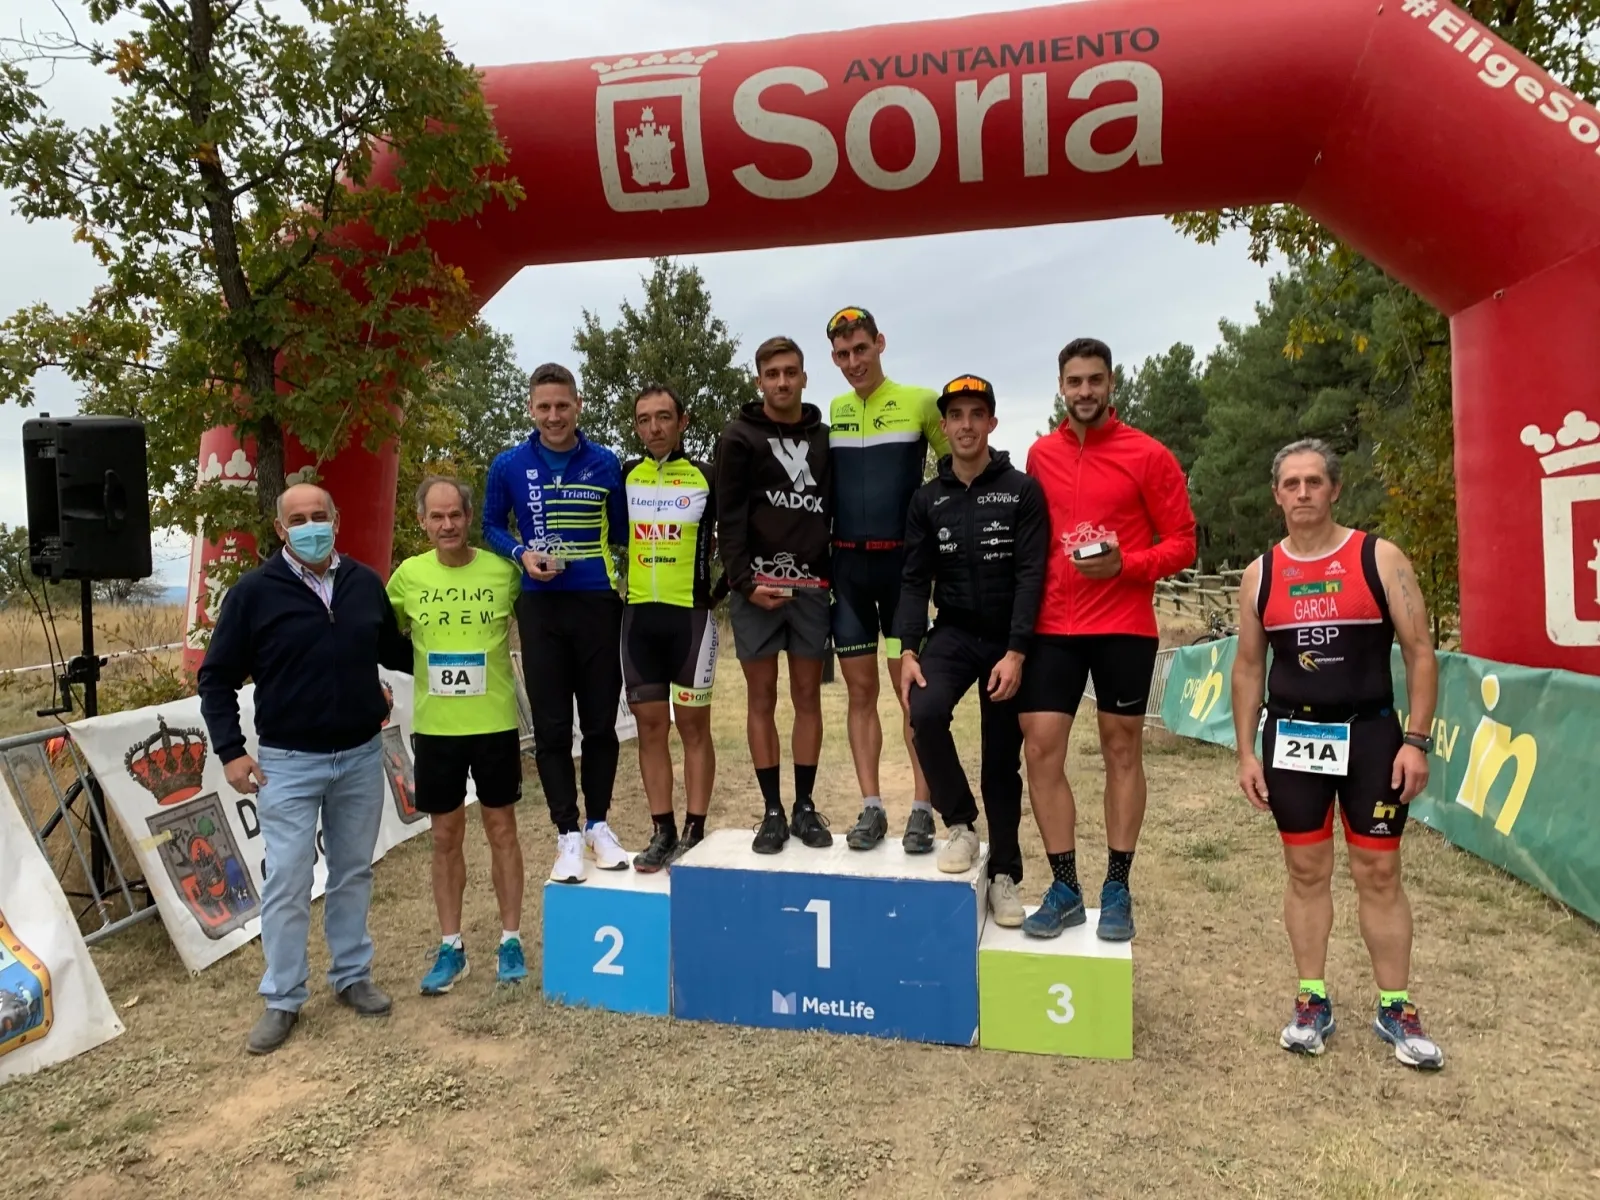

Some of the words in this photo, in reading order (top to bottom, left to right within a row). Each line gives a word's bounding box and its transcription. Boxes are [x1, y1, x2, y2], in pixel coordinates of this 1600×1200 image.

[843, 26, 1160, 84] AYUNTAMIENTO
[1401, 0, 1600, 157] #EligeSo
[731, 60, 1164, 201] Soria
[766, 490, 824, 513] VADOX
[419, 587, 494, 604] RACING
[419, 611, 494, 627] CREW
[1293, 596, 1339, 621] GARCIA
[1297, 626, 1340, 646] ESP
[441, 669, 471, 686] 8A
[1285, 739, 1338, 762] 21A
[1455, 674, 1538, 837] in
[803, 898, 832, 969] 1
[592, 925, 625, 976] 2
[802, 997, 876, 1021] MetLife
[1046, 983, 1076, 1024] 3
